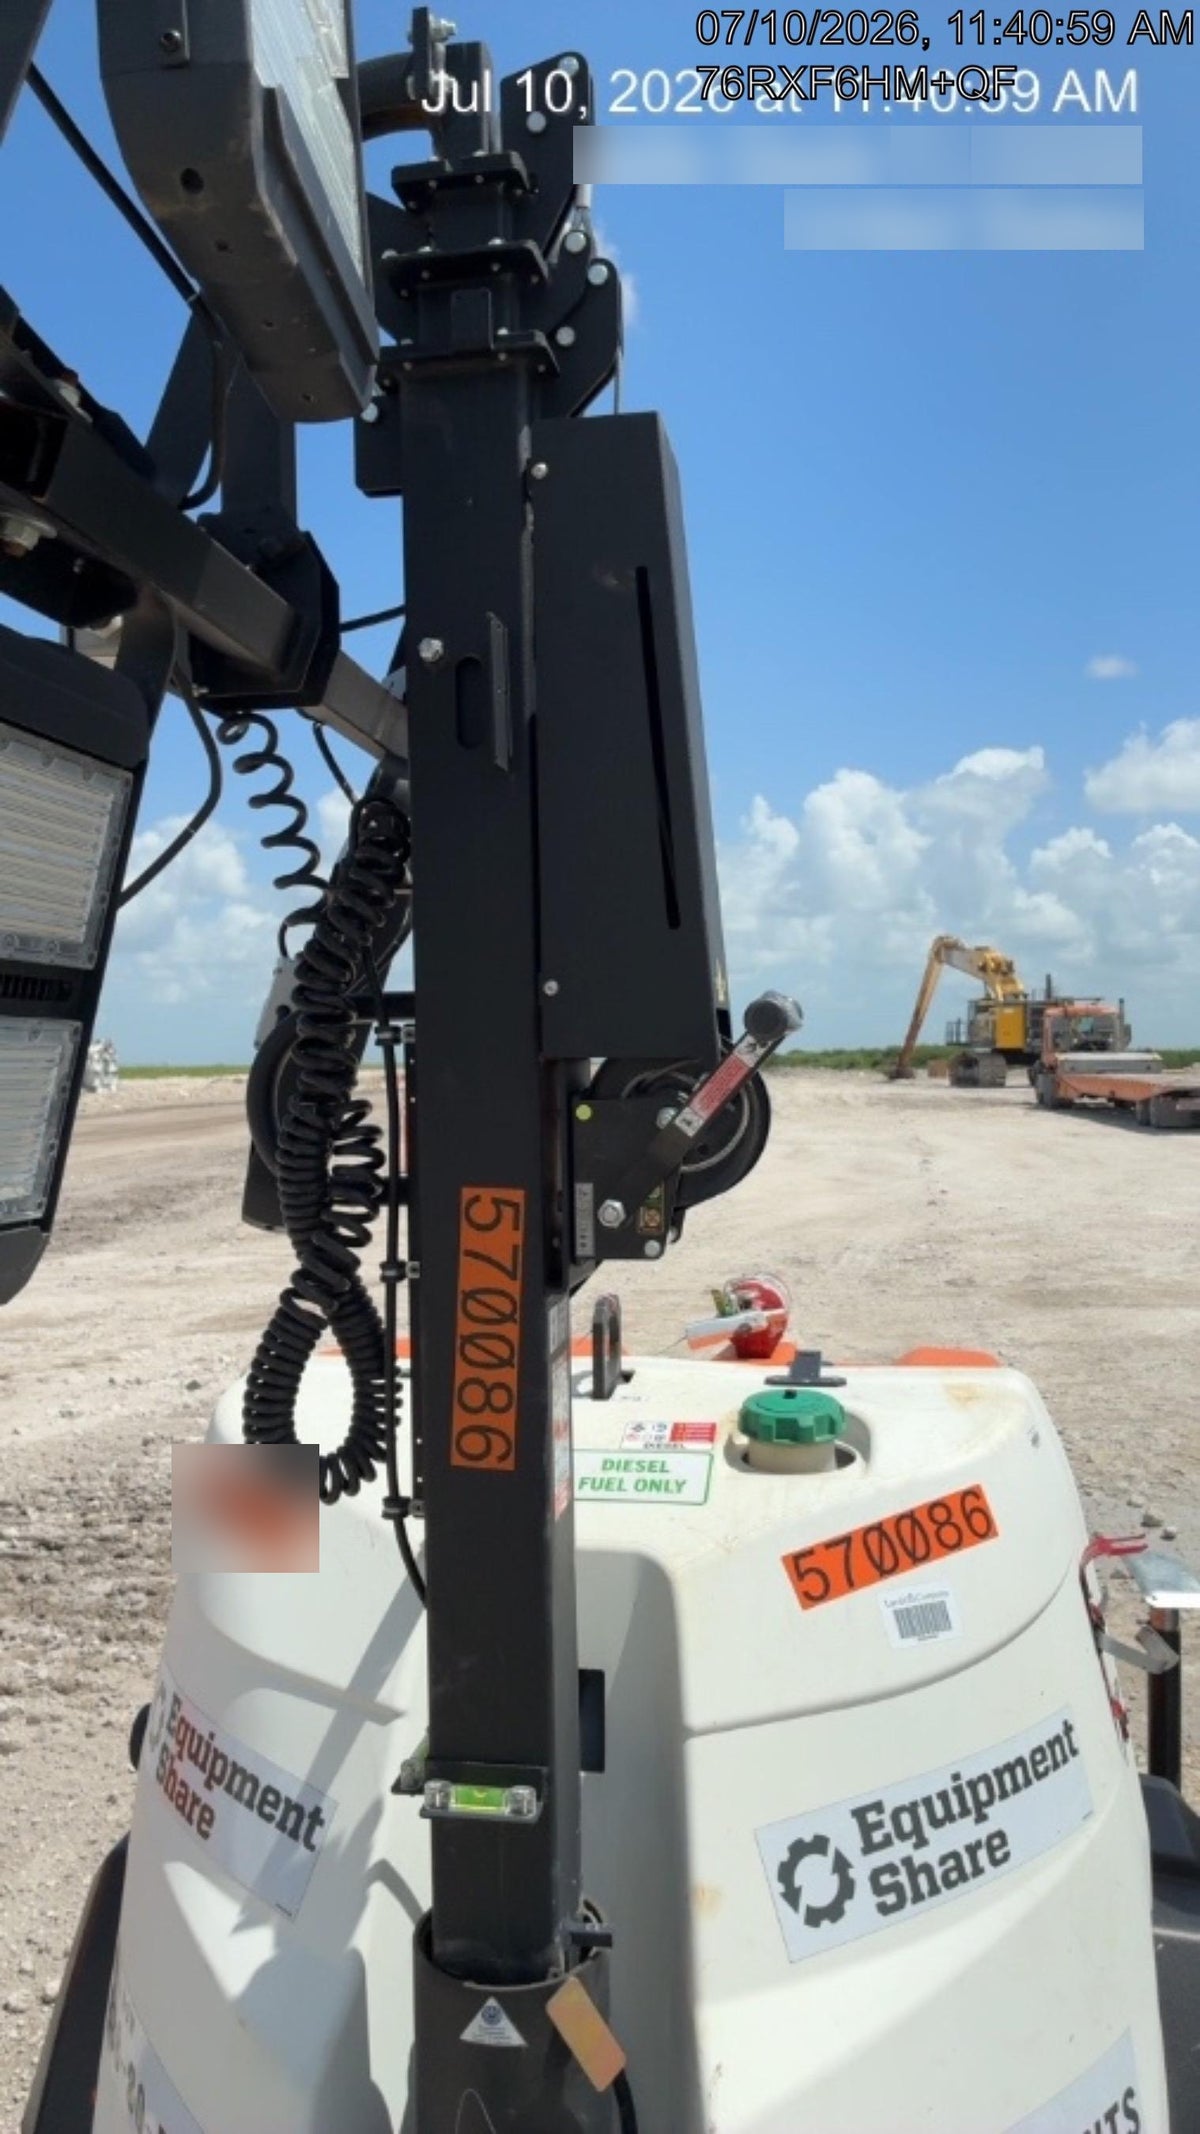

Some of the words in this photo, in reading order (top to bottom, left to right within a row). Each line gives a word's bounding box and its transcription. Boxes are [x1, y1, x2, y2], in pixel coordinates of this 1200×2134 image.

[455, 1194, 521, 1463] 570086
[578, 1477, 627, 1492] FUEL
[633, 1478, 687, 1494] ONLY
[601, 1458, 670, 1473] DIESEL
[792, 1490, 993, 1602] 570086
[156, 1741, 215, 1840] Share
[165, 1692, 325, 1852] Equipment
[850, 1719, 1079, 1857] Equipment
[868, 1828, 1011, 1917] Share
